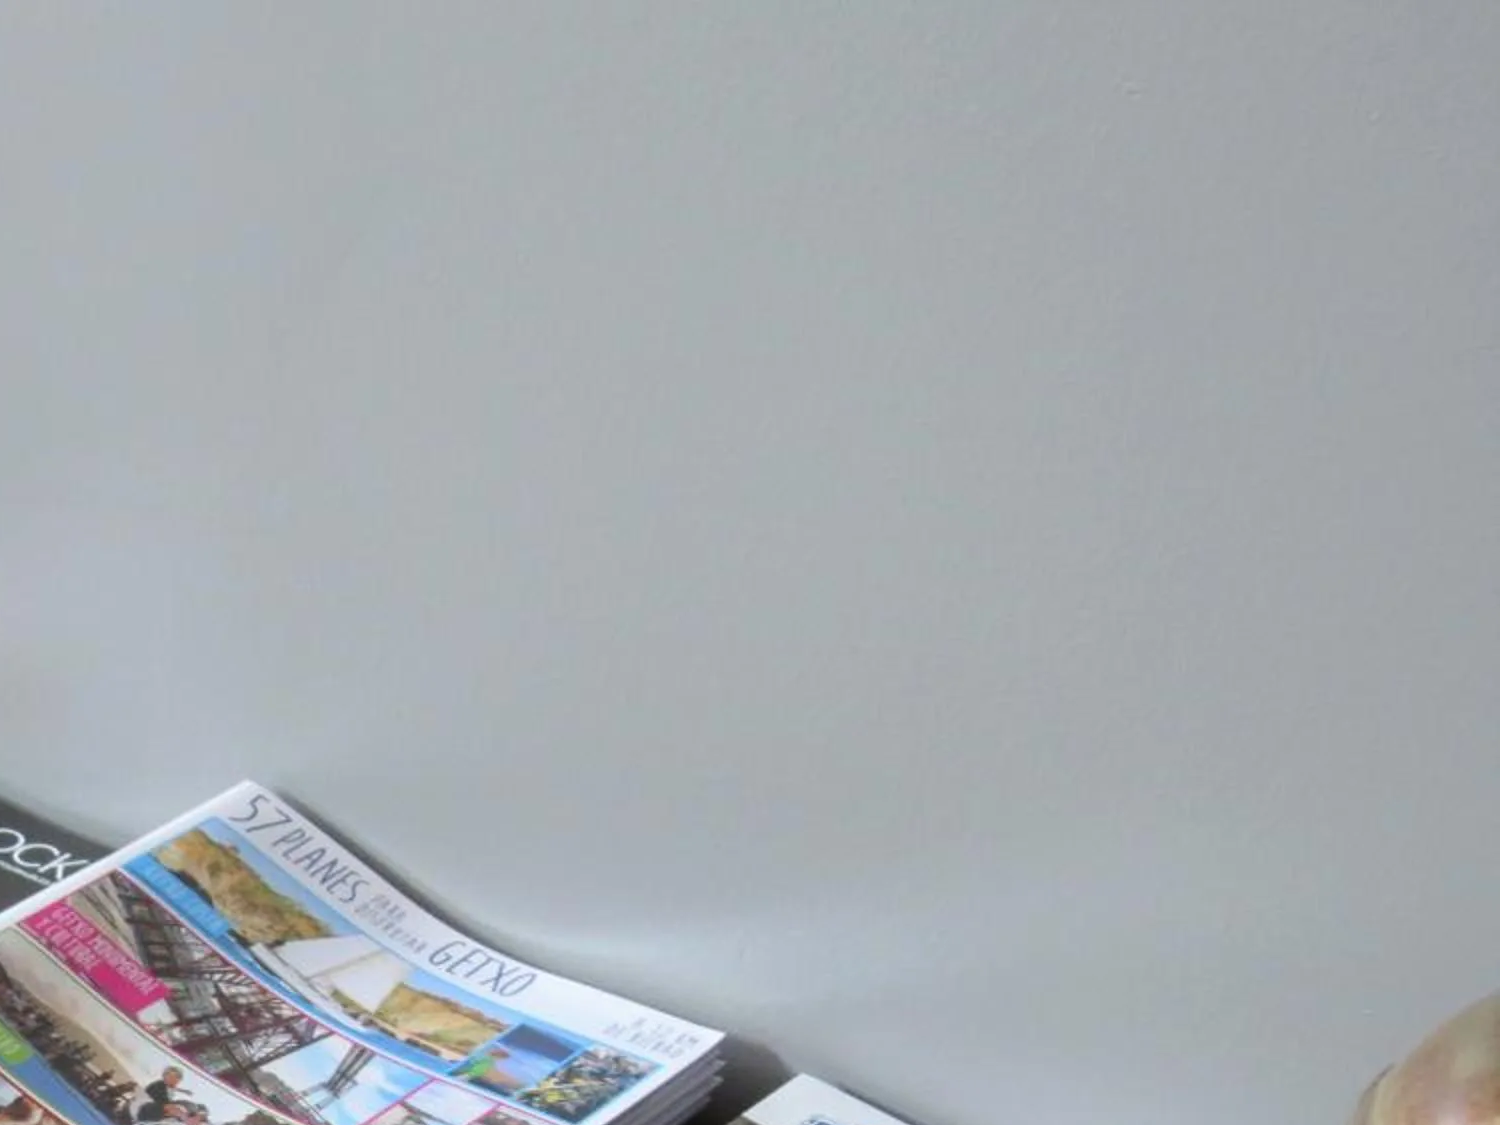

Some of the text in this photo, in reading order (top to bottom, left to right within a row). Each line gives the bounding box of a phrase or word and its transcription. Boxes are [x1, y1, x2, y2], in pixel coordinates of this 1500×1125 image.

[228, 793, 294, 835] 57
[270, 828, 371, 905] PLANES
[428, 939, 539, 998] GETXO
